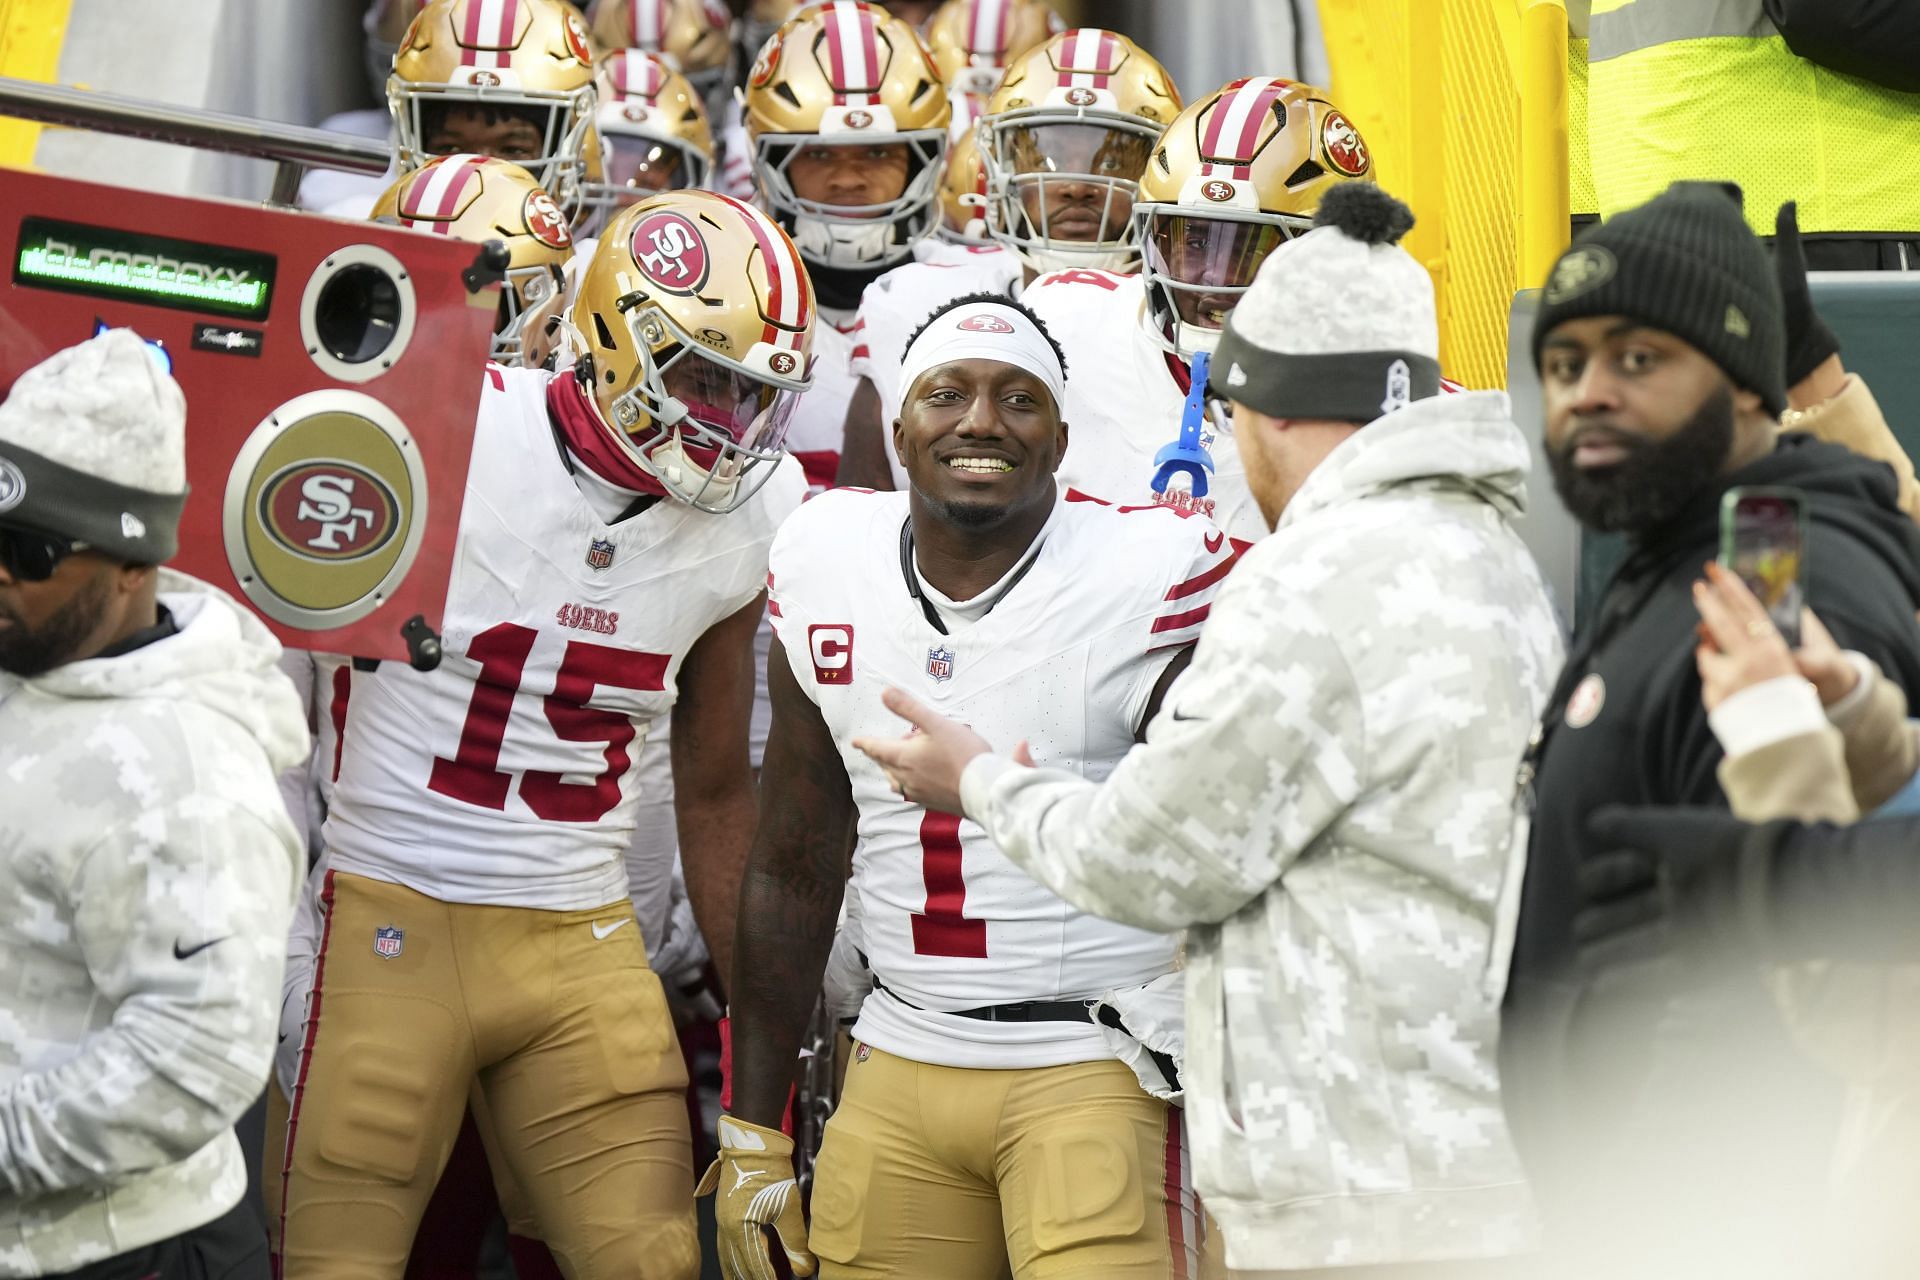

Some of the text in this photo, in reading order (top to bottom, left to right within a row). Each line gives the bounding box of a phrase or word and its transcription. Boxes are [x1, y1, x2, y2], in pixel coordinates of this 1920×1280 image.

[638, 222, 697, 279] SF
[694, 334, 732, 351] OAKLEY
[298, 474, 374, 550] SF
[590, 550, 610, 567] NFL
[556, 602, 620, 635] 49ERS
[812, 628, 850, 669] C
[930, 660, 949, 677] NFL
[427, 621, 673, 822] 15
[379, 939, 399, 953] NFL
